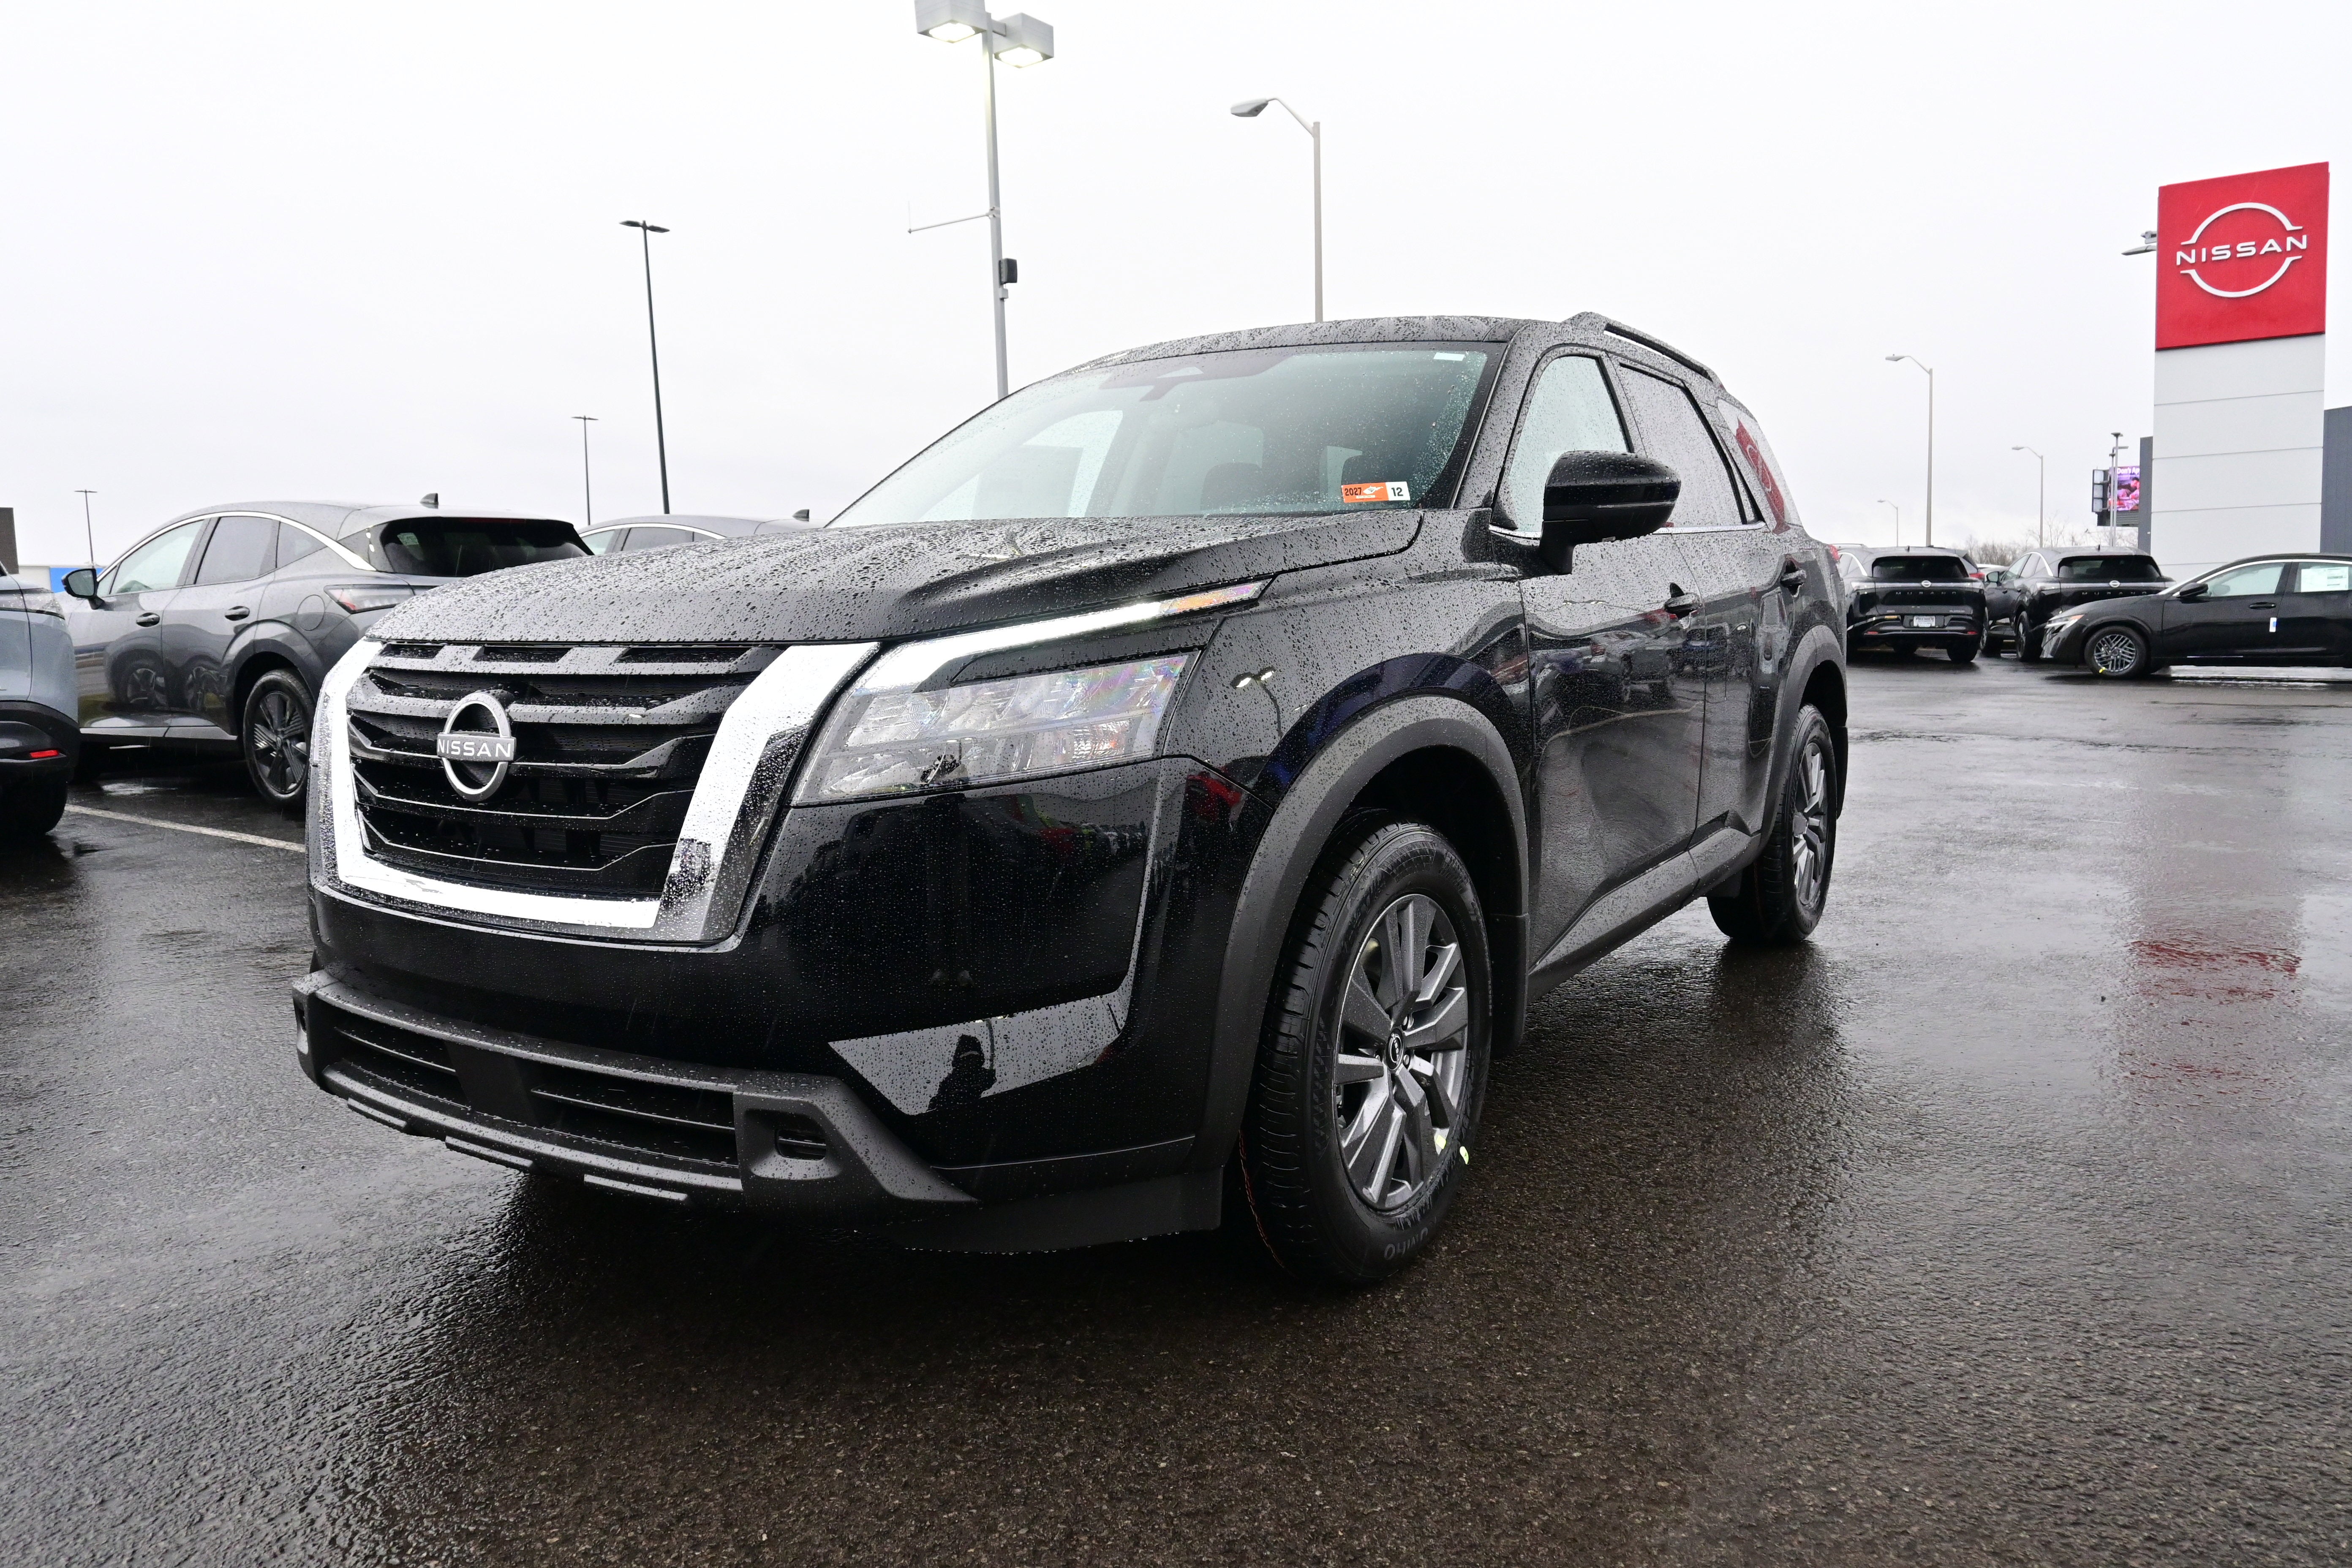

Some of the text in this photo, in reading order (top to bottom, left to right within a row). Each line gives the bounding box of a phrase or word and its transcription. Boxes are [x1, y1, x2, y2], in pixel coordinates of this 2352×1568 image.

[2176, 234, 2307, 266] NISSAN
[1345, 487, 1404, 496] 2027 12
[438, 739, 511, 757] NISSAN
